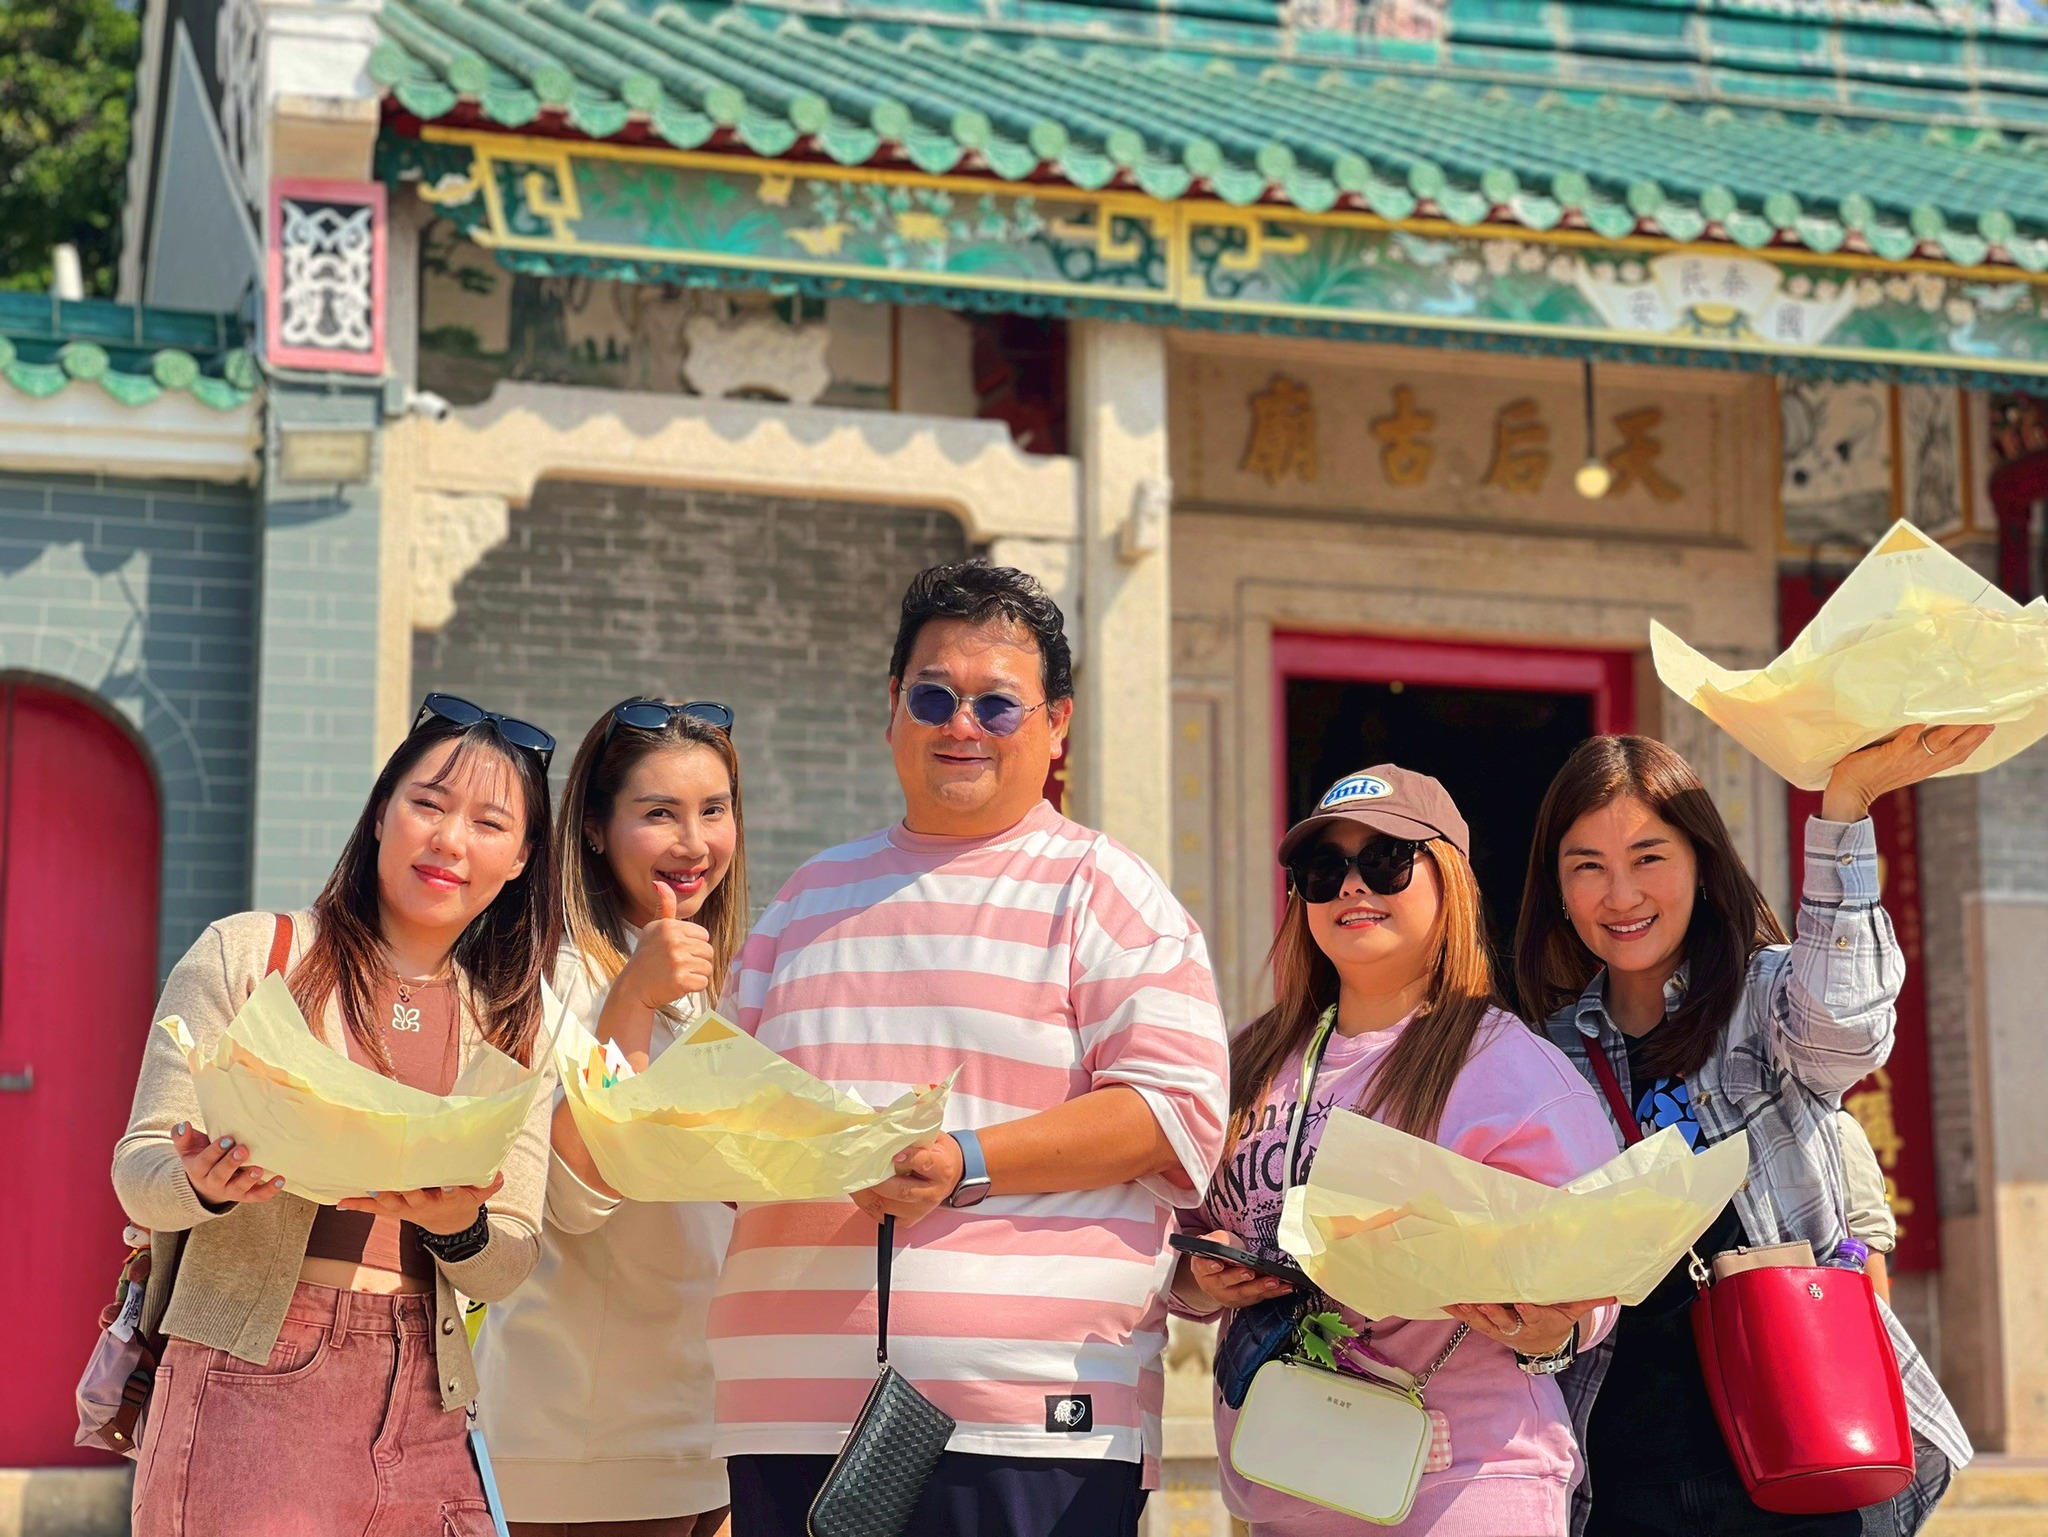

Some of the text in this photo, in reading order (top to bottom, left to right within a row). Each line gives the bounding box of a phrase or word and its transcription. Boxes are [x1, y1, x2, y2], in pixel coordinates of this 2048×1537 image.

[1239, 374, 1683, 502] 天后古廟
[1324, 780, 1380, 805] emis
